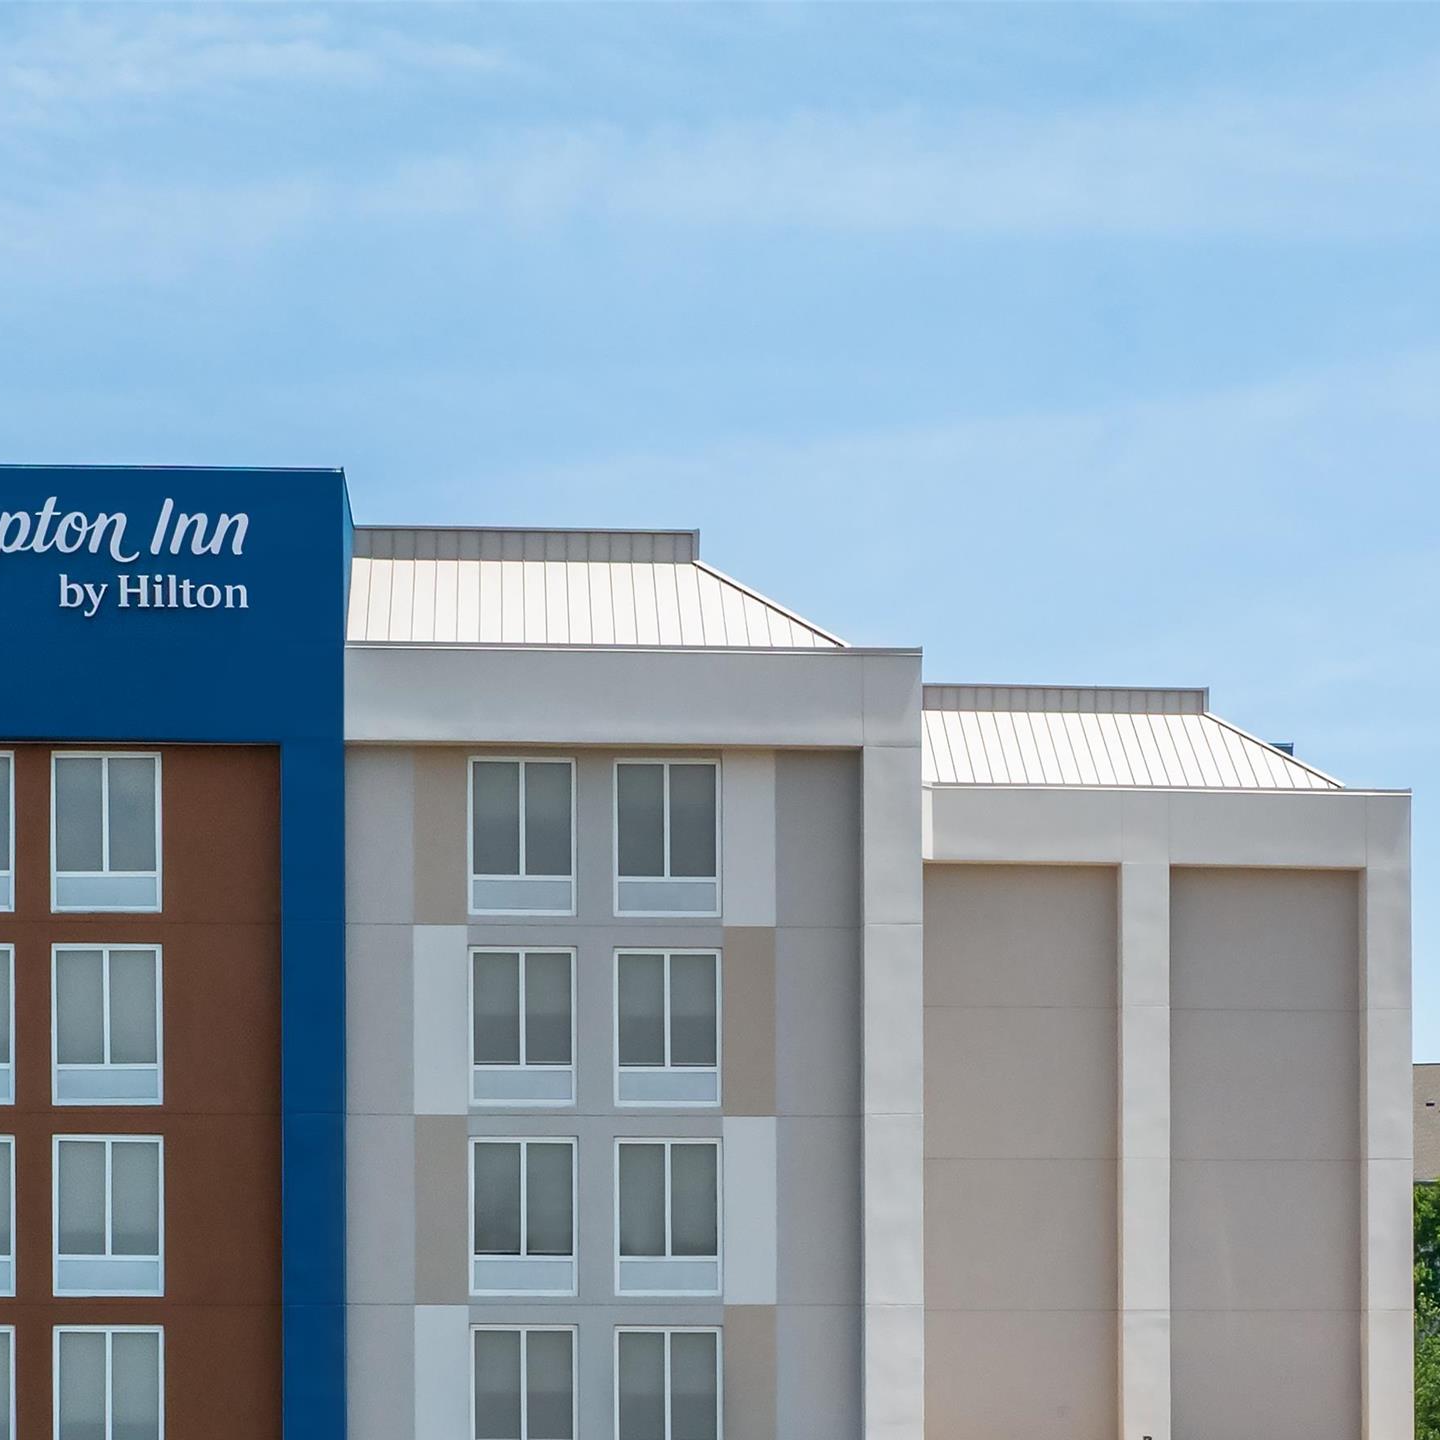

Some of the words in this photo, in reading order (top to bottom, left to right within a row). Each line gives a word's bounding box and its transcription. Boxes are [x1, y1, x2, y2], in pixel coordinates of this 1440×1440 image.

[150, 497, 250, 556] Inn
[59, 574, 107, 617] by
[118, 574, 249, 609] Hilton
